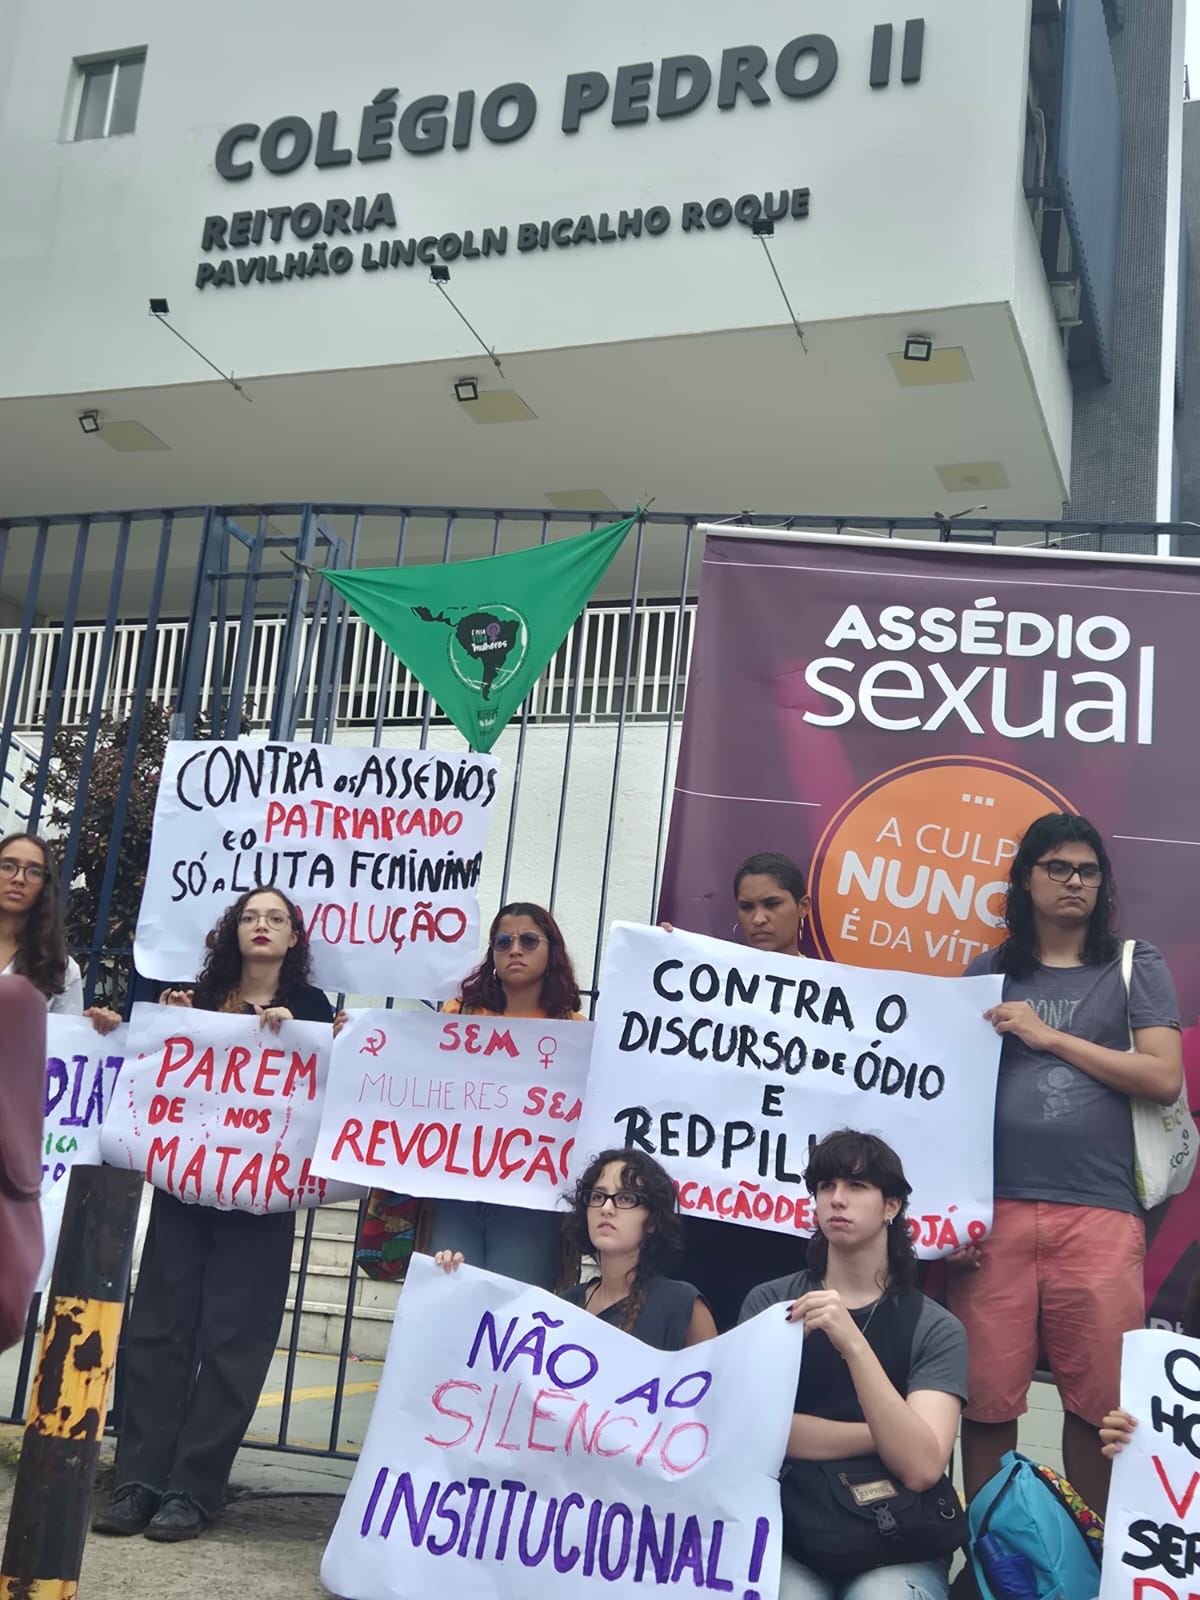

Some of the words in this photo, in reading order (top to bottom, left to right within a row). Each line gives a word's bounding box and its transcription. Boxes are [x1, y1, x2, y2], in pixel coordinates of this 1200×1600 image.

[214, 83, 537, 181] COLÉGIO
[561, 33, 838, 133] PEDRO
[869, 18, 925, 88] II
[195, 244, 353, 289] PAVILHÃO
[361, 226, 508, 271] LINCOLN
[517, 206, 670, 251] BICALHO
[681, 187, 811, 229] ROQUE
[200, 192, 397, 251] REITORIA
[825, 597, 1131, 661] ASSÉDIO
[803, 645, 1154, 744] sexual
[176, 746, 324, 811] CONTRA
[264, 800, 464, 843] PATRIARCADO
[876, 817, 902, 847] A
[916, 824, 1018, 867] CULP
[171, 851, 207, 902] SÓ
[232, 851, 335, 893] LUTA
[837, 850, 1010, 929] NUNC
[297, 901, 468, 954] VOLUÇÃO
[840, 908, 861, 942] É
[869, 921, 912, 953] DA
[925, 929, 989, 965] VÍT
[652, 959, 855, 1031] CONTRA
[875, 994, 908, 1034] O
[155, 1036, 318, 1101] PAREM
[439, 1022, 520, 1058] SEM
[618, 1010, 808, 1076] DISCURSO
[811, 1048, 847, 1076] DE
[853, 1039, 945, 1100] ÓDIO
[147, 1094, 186, 1124] DE
[223, 1107, 272, 1133] NOS
[358, 1072, 509, 1111] MULHERES
[761, 1084, 785, 1117] E
[45, 1132, 78, 1155] ICA
[466, 1311, 599, 1389] NÃO
[615, 1370, 713, 1414] AO
[360, 1466, 770, 1600] INSTITUCIONAL!
